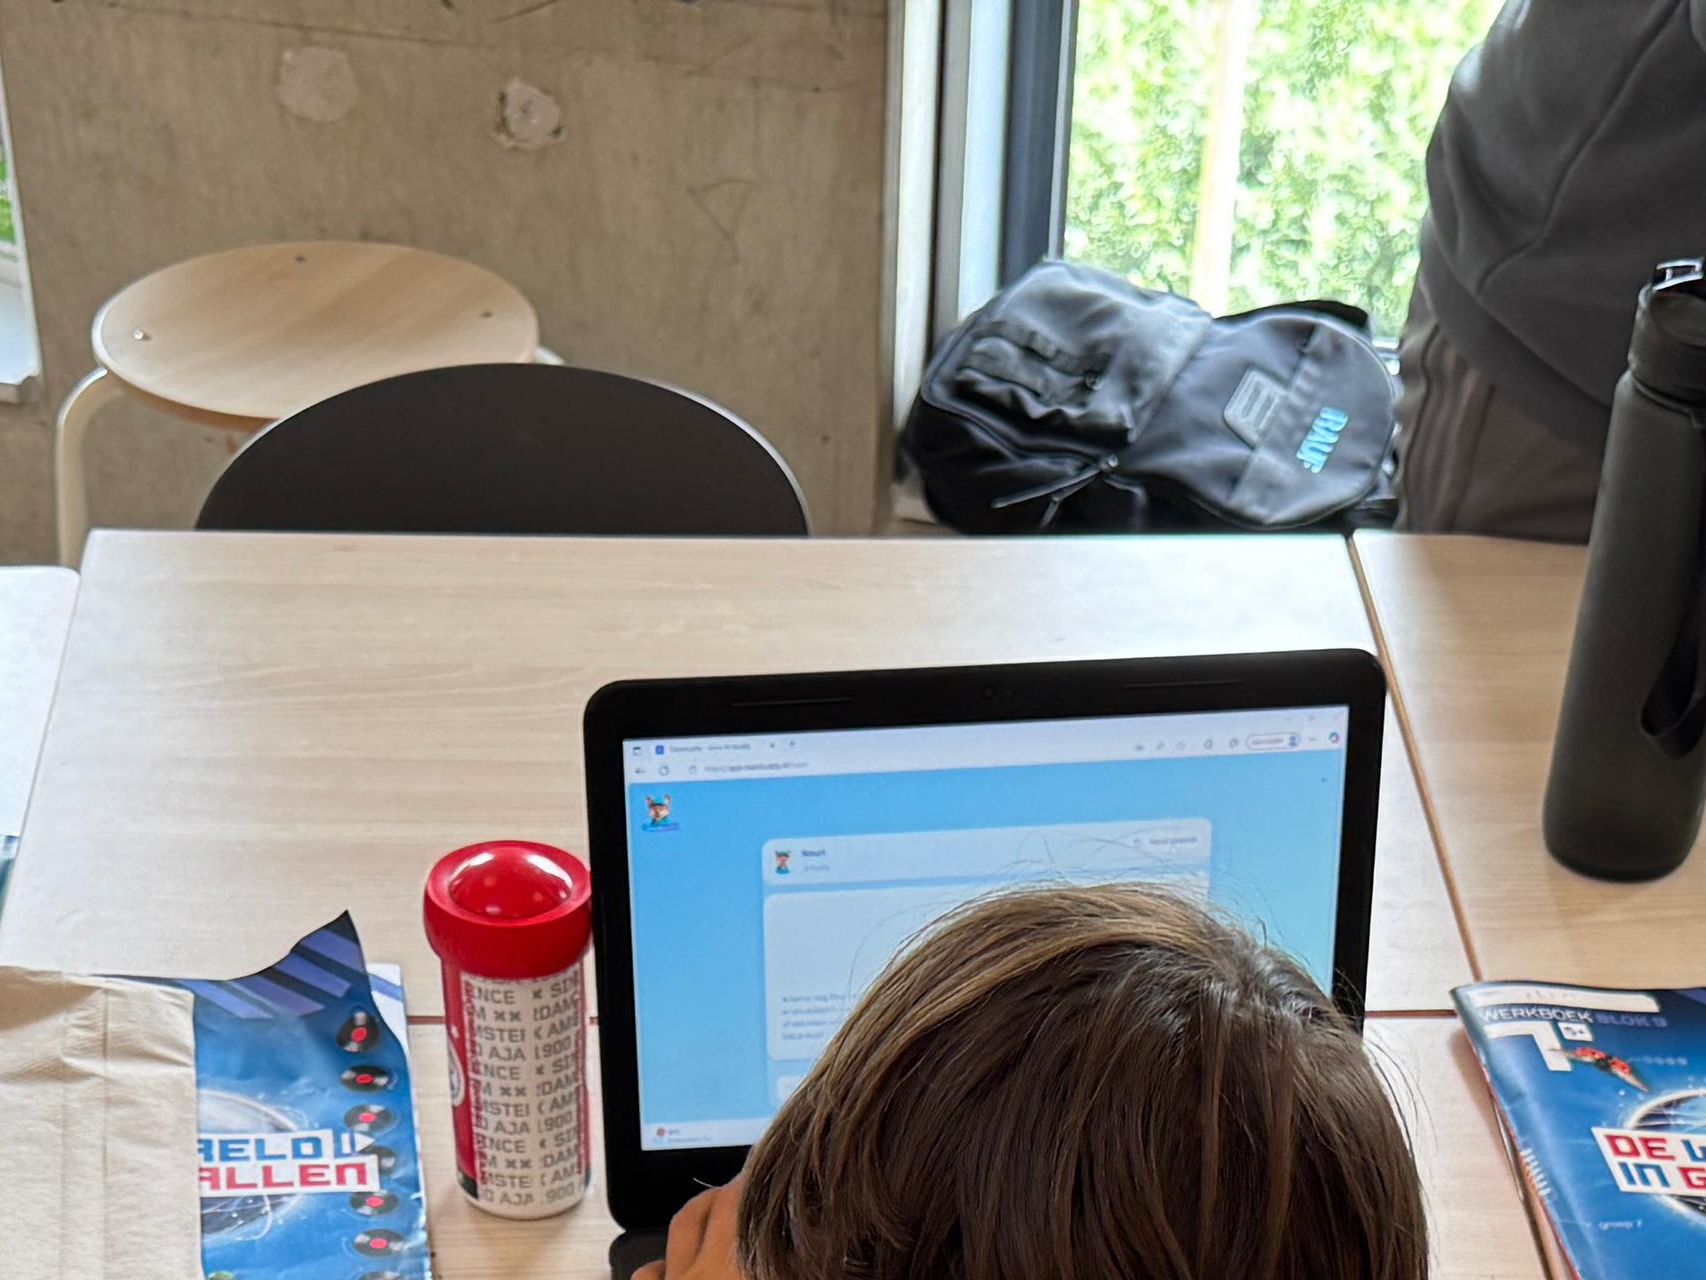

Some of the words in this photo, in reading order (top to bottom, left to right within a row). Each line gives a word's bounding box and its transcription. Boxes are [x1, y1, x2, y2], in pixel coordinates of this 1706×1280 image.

[1481, 1006, 1594, 1024] WERKBOEK
[1595, 1012, 1650, 1027] BLOK
[1603, 1134, 1676, 1161] DE
[198, 1162, 367, 1191] ALLEN
[1617, 1161, 1671, 1188] IN
